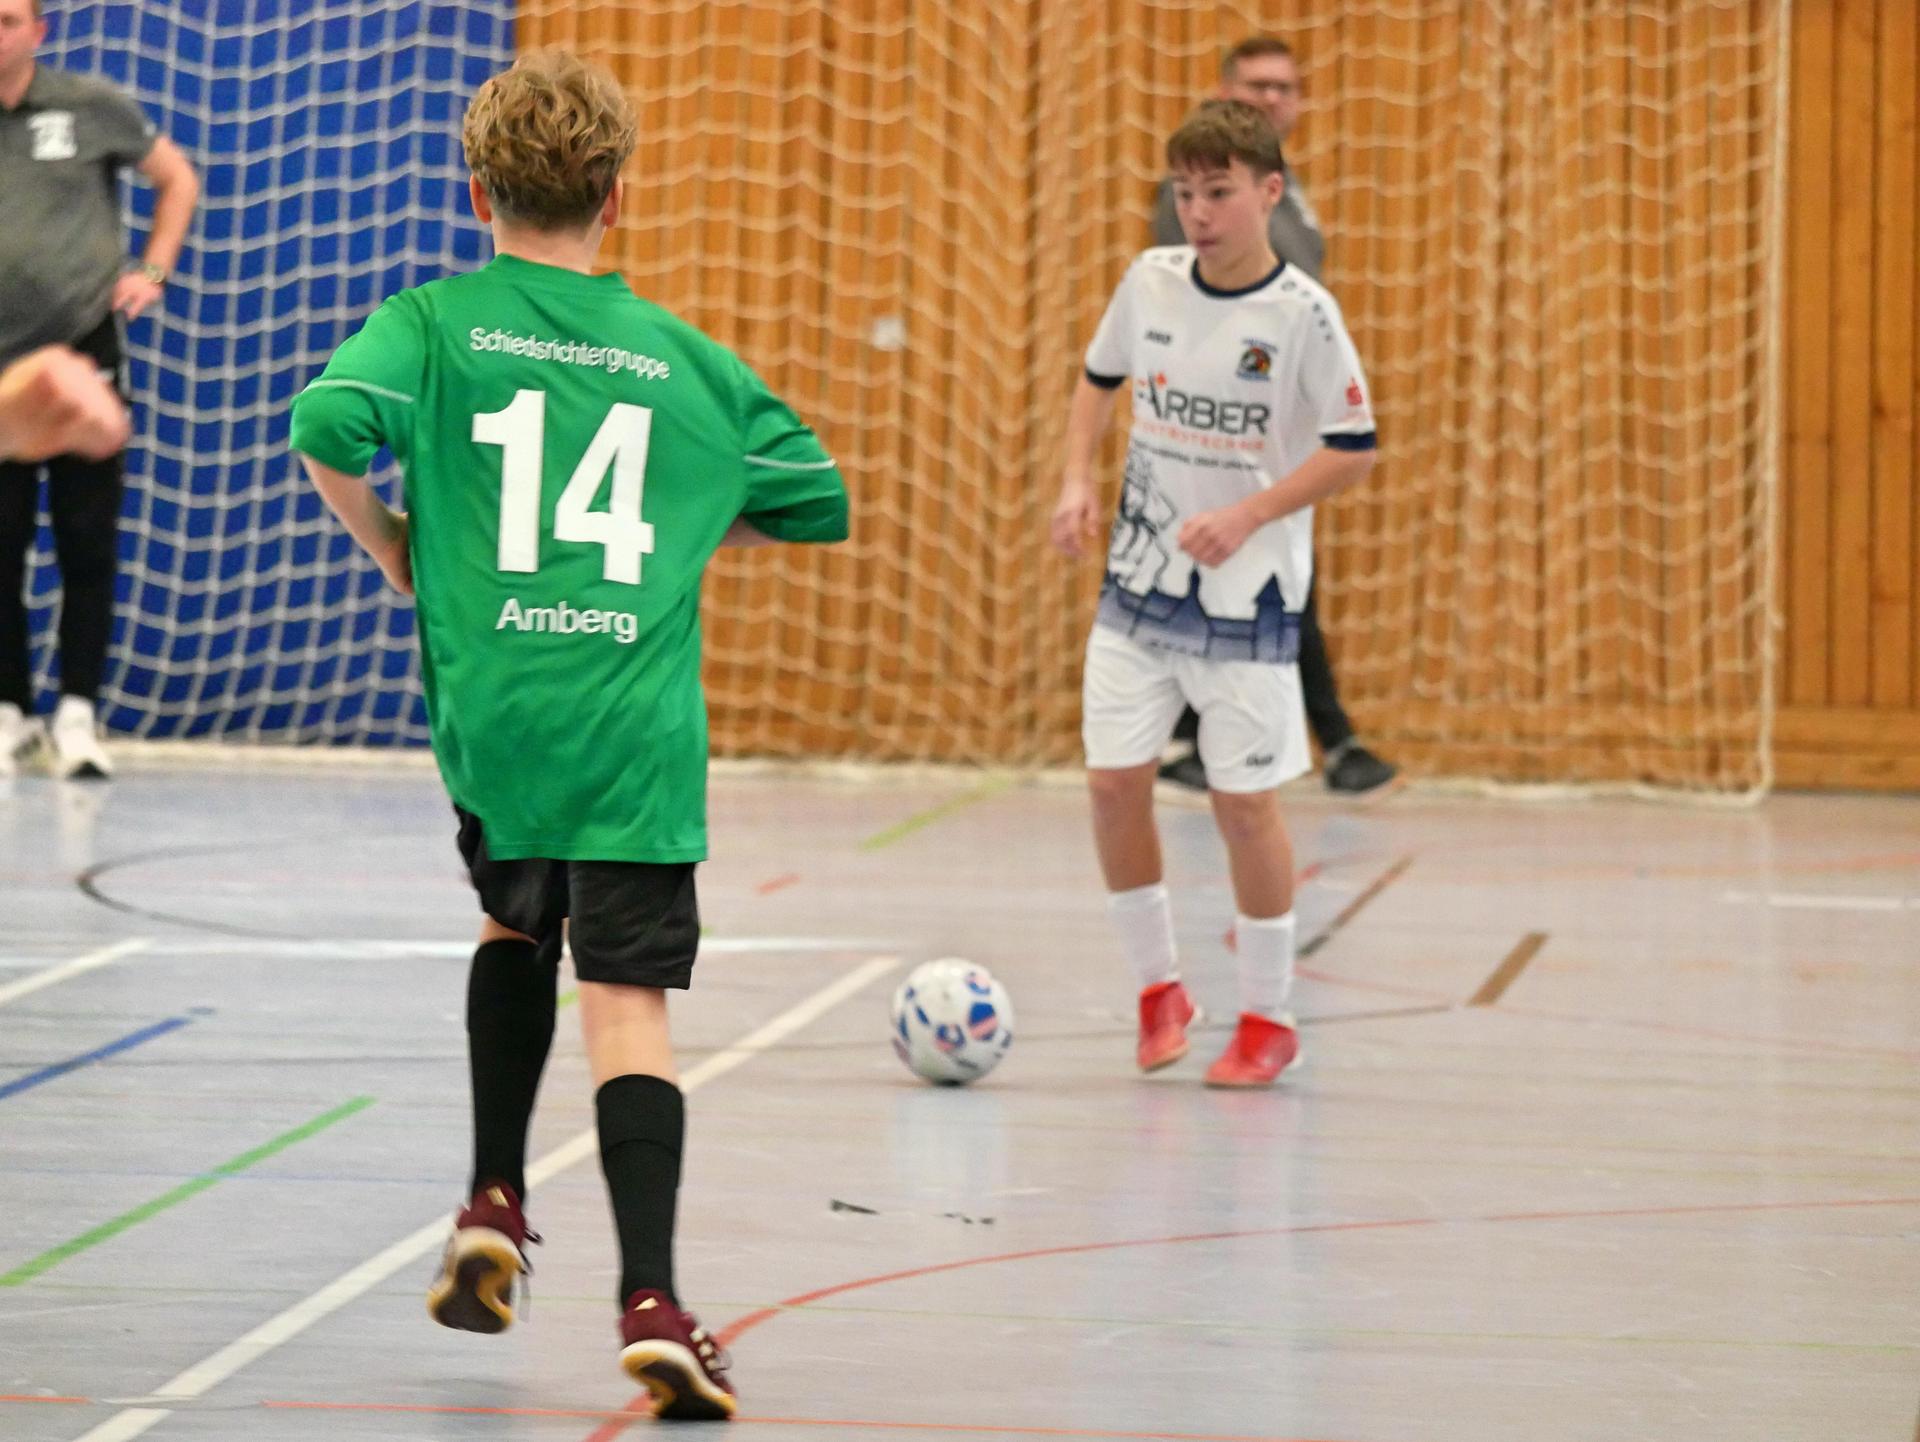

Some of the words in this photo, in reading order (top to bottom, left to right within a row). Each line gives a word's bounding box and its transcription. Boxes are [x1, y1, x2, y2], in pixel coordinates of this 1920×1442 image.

[469, 327, 671, 381] Schiedsrichtergruppe
[471, 388, 655, 585] 14
[495, 597, 638, 644] Amberg
